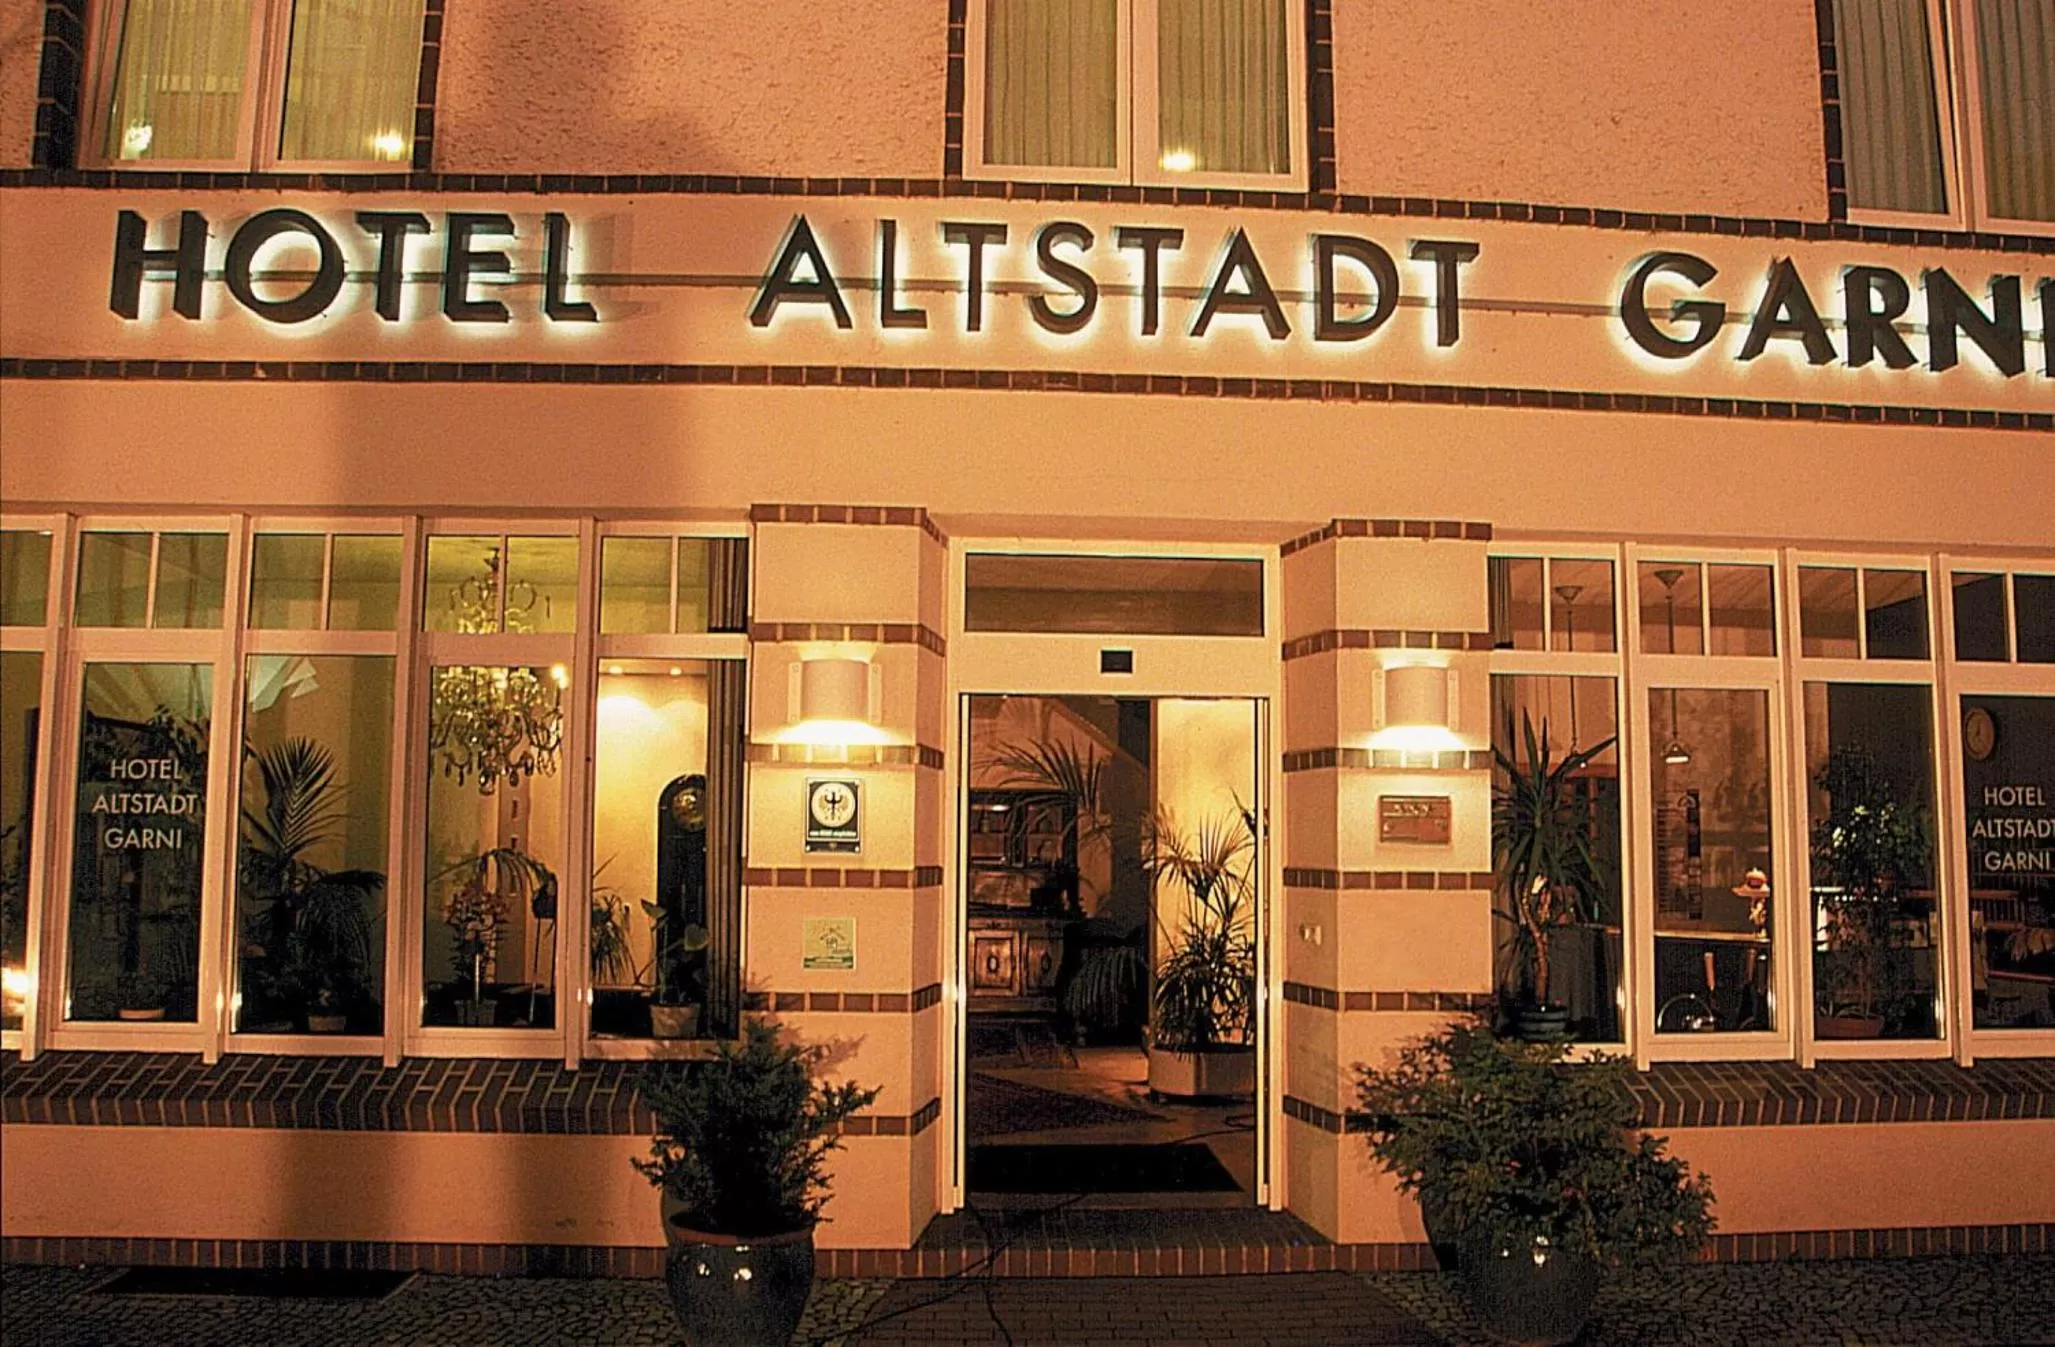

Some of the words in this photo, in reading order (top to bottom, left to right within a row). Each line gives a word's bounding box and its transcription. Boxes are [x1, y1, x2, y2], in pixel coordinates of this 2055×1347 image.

[110, 208, 600, 323] HOTEL
[748, 213, 1480, 347] ALTSTADT
[111, 759, 183, 779] HOTEL
[91, 794, 198, 814] ALTSTADT
[1984, 786, 2046, 806] HOTEL
[104, 828, 182, 849] GARNI
[1984, 850, 2050, 871] GARNI
